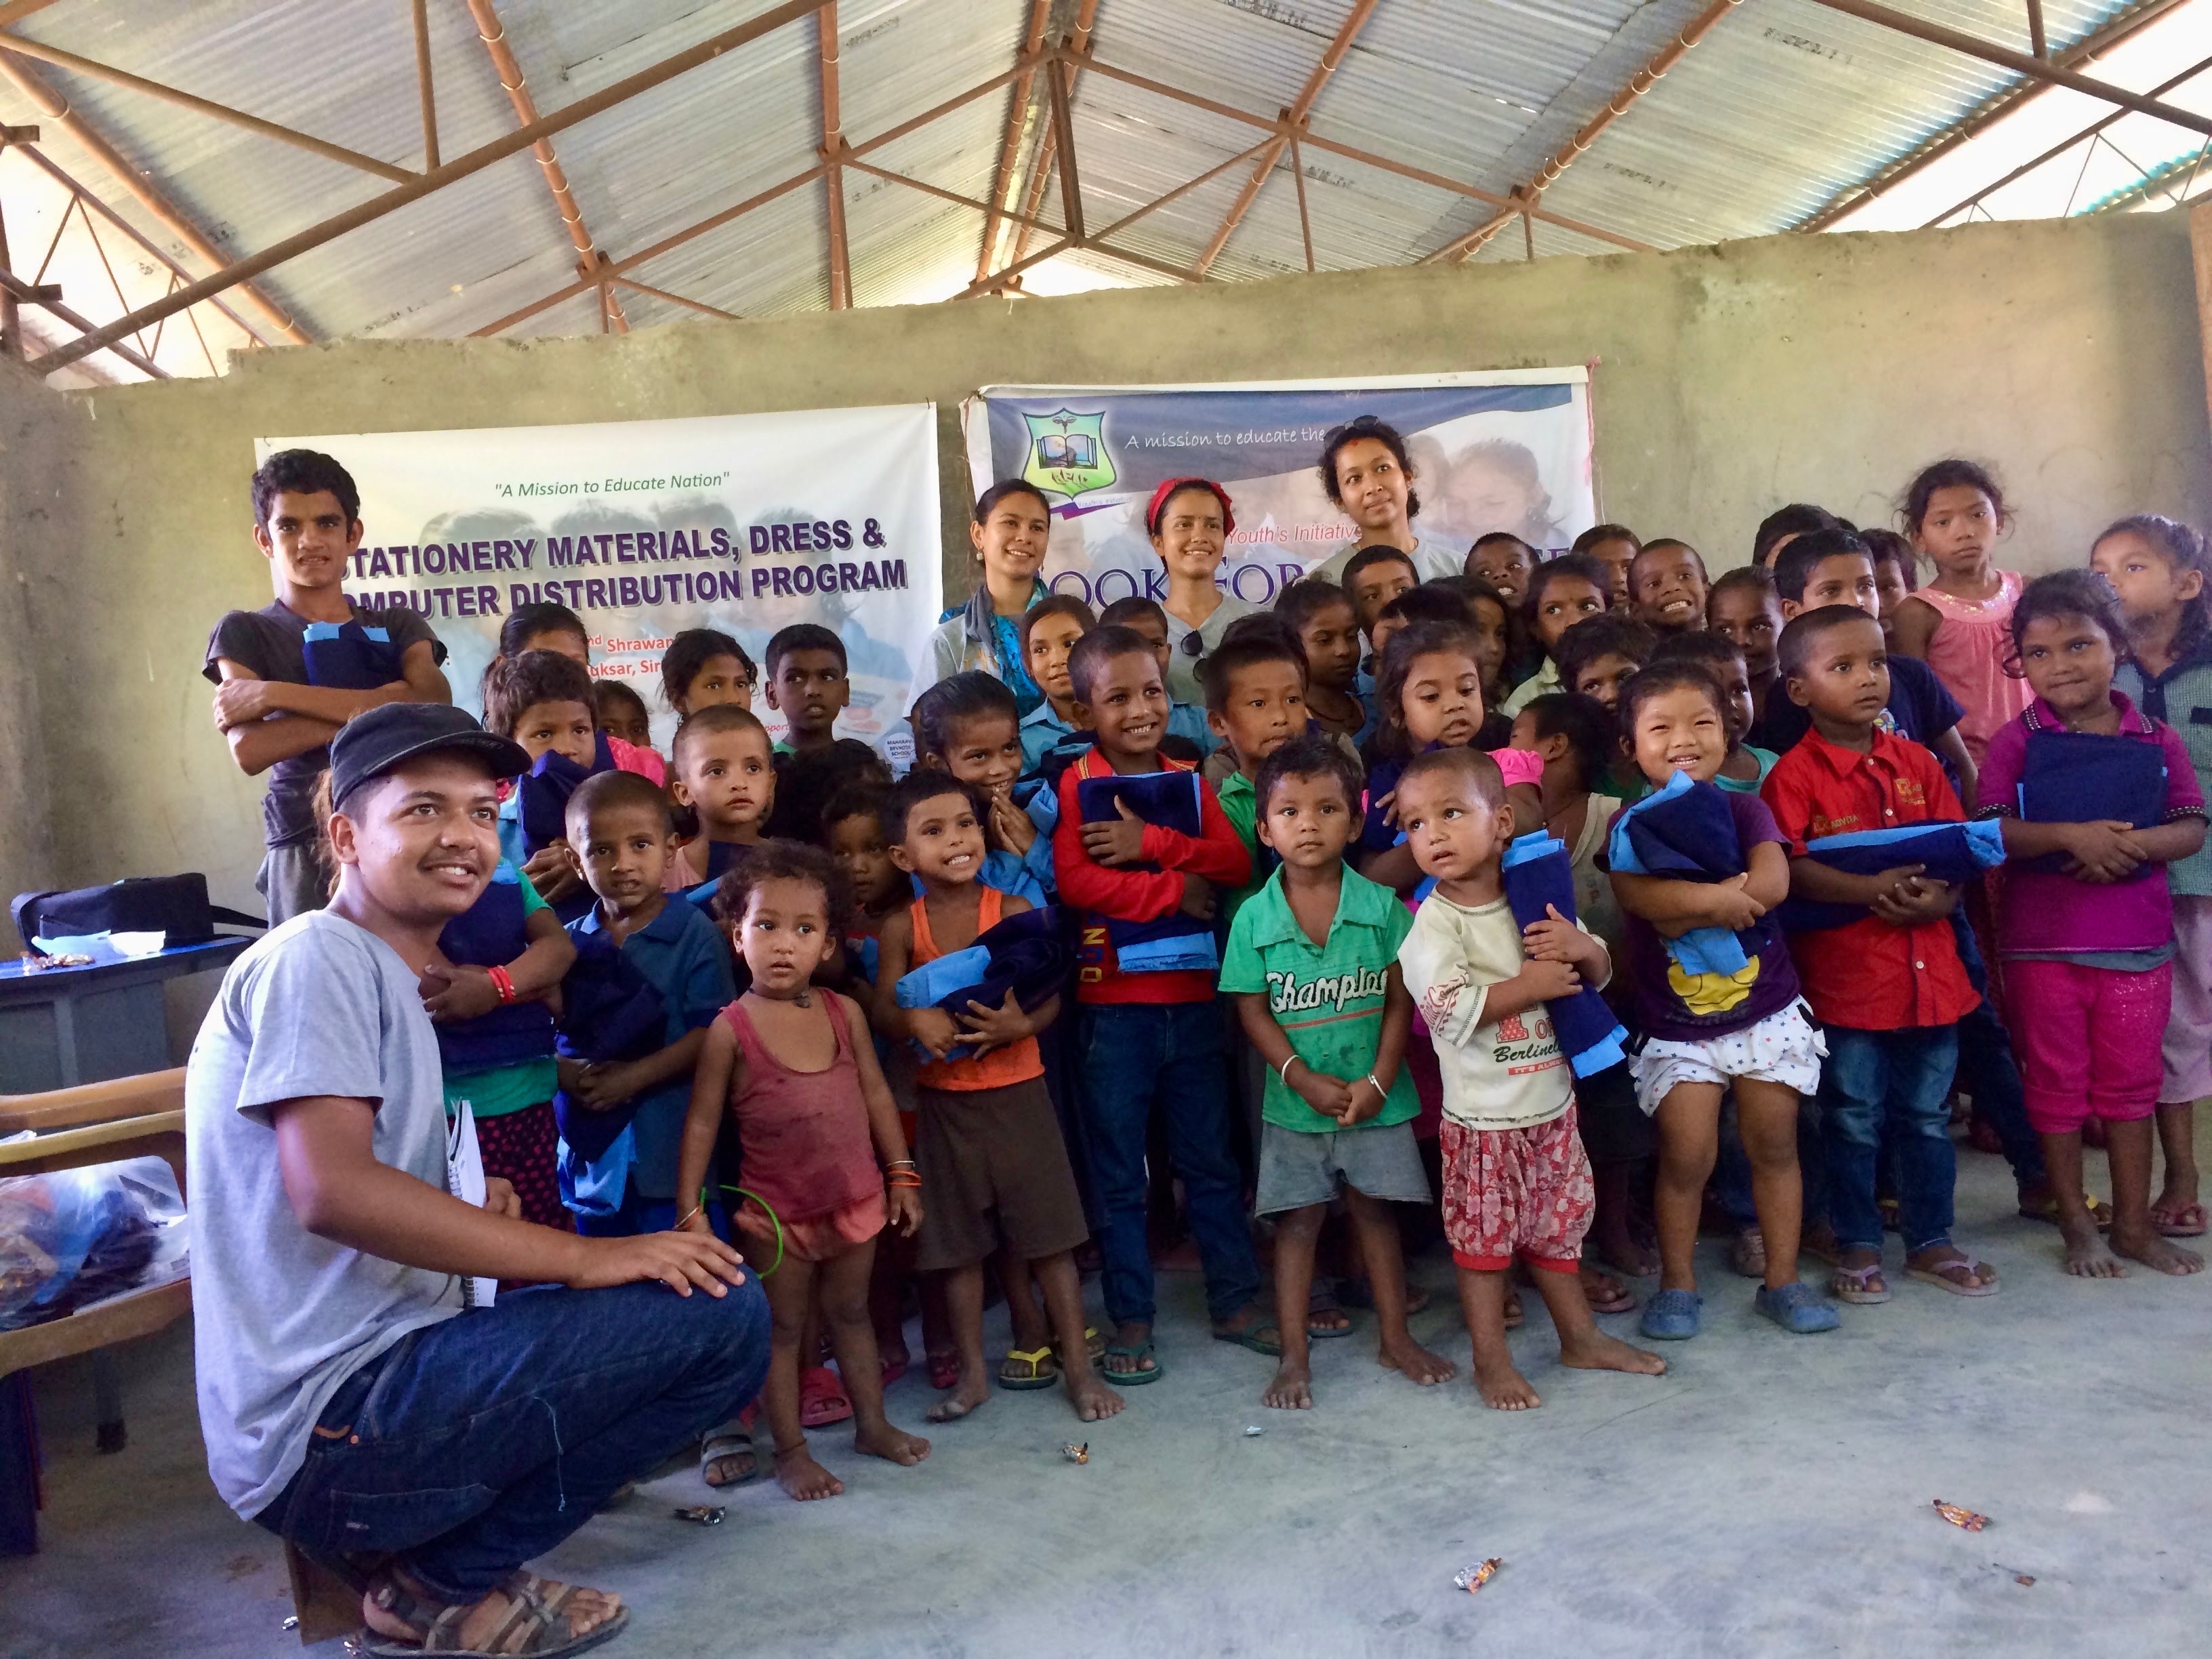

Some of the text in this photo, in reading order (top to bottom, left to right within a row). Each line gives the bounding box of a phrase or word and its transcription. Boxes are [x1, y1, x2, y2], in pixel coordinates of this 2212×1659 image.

[1124, 427, 1325, 449] A mission to educate the
[495, 471, 730, 497] "A Mission to Educate Nation"
[1227, 526, 1288, 545] Youth's
[342, 517, 886, 580] TATIONERY MATERIALS, DRESS &
[343, 558, 907, 620] MPUTER DISTRIBUTION PROGRAM
[1036, 569, 1170, 609] OOK
[588, 634, 674, 652] nd Shrawan
[590, 659, 661, 677] uksar, Sir
